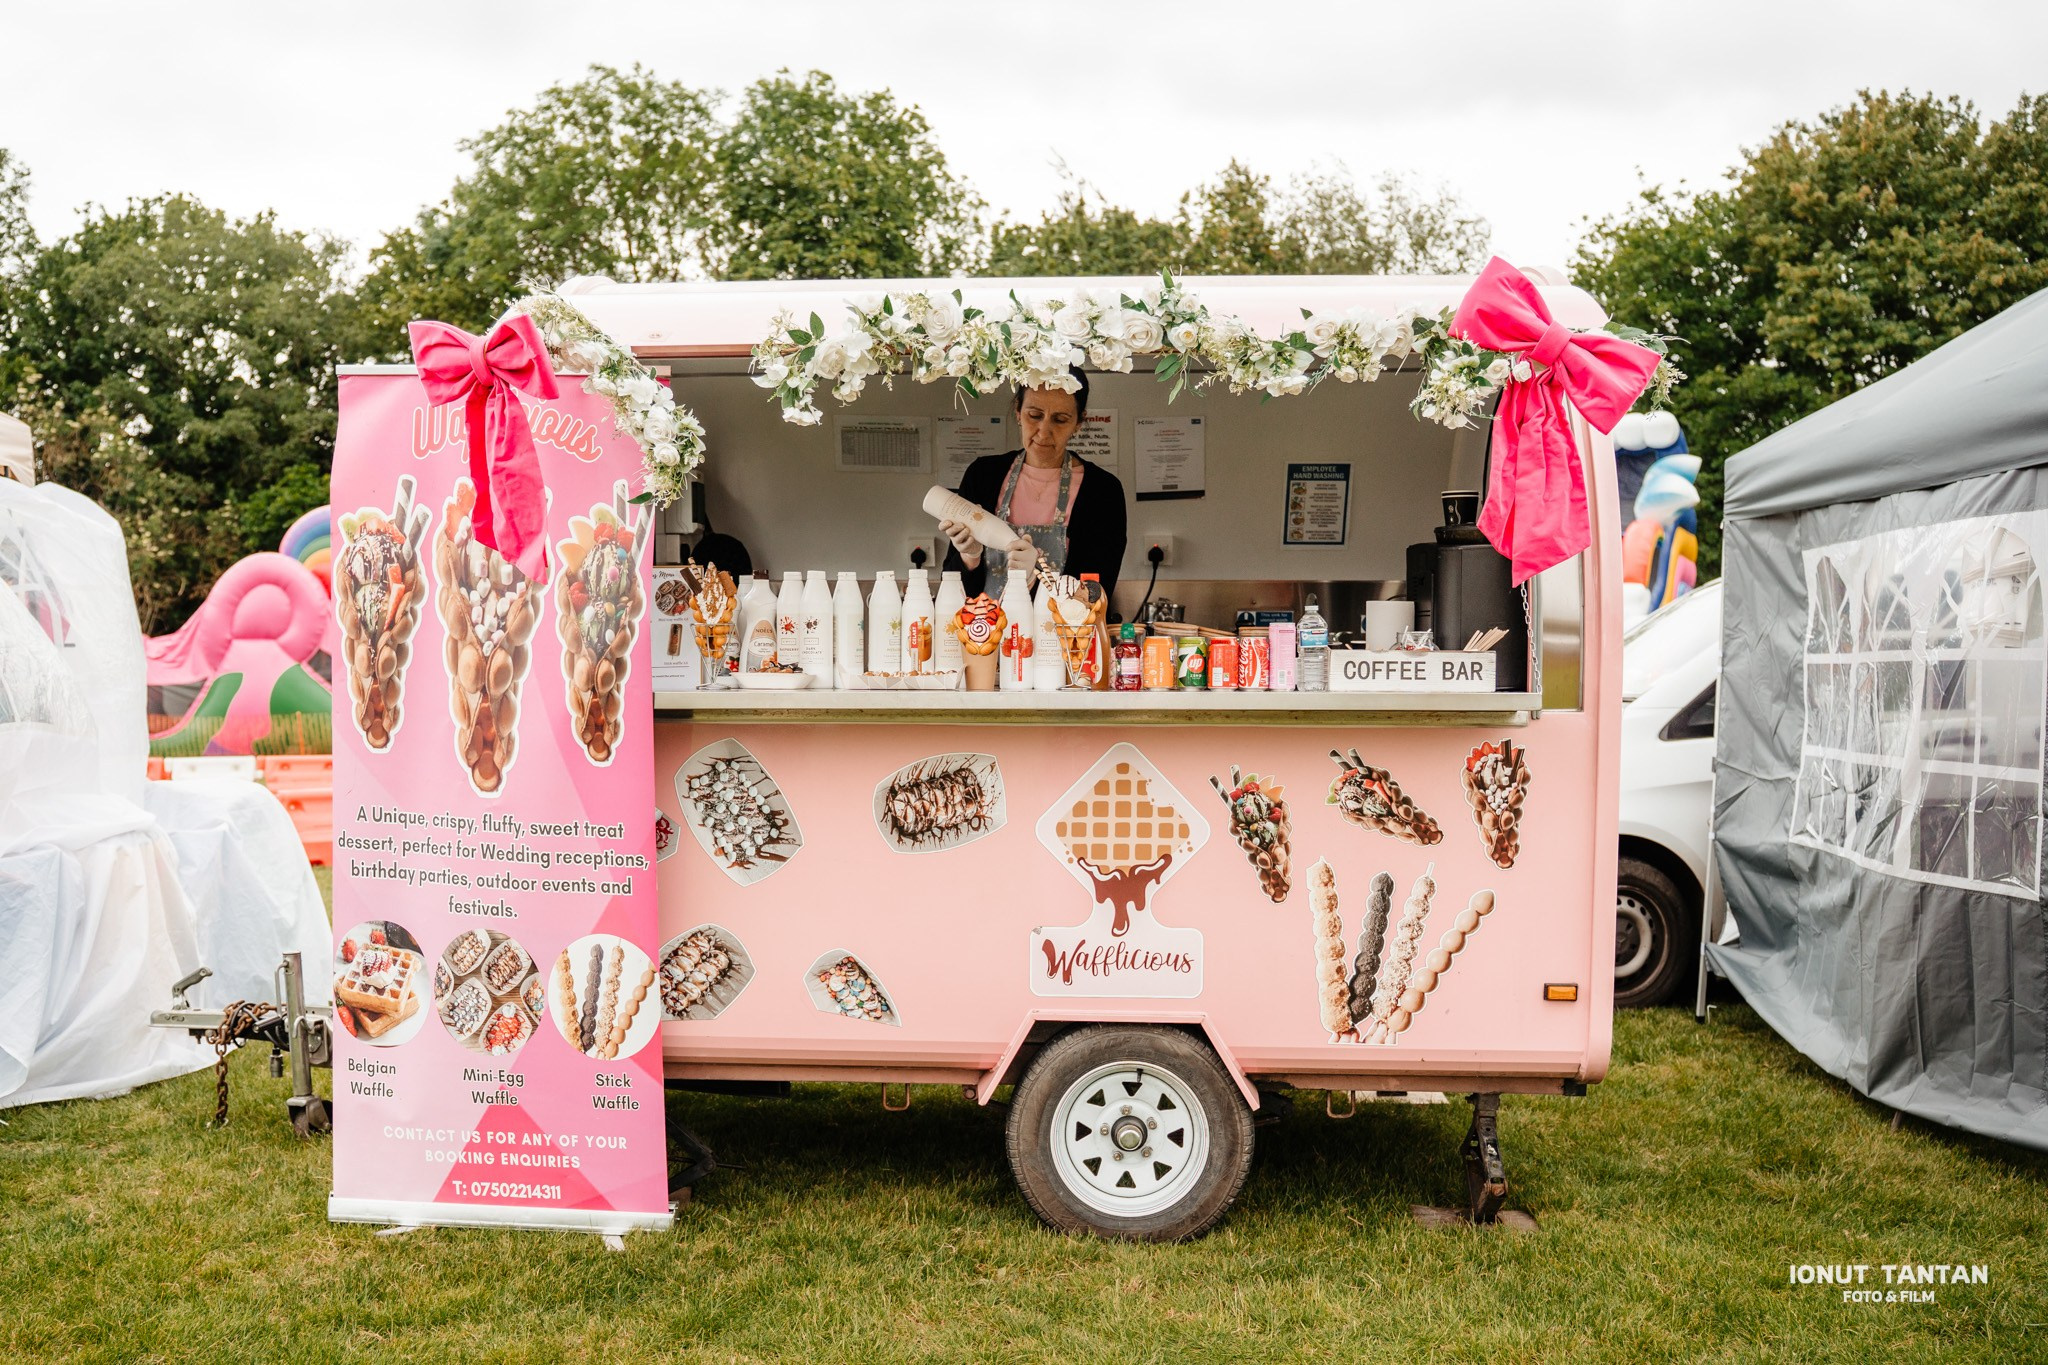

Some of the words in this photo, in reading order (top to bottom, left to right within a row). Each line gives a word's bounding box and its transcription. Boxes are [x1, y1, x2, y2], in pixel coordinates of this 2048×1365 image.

[412, 388, 604, 464] Waious
[1343, 660, 1427, 681] COFFEE
[1442, 661, 1483, 681] BAR
[356, 805, 367, 823] A
[372, 806, 429, 828] Unique,
[432, 812, 478, 836] crispy,
[482, 813, 526, 838] fluffy,
[530, 820, 580, 838] sweet
[584, 821, 625, 839] treat
[338, 831, 398, 856] dessert,
[402, 838, 453, 857] perfect
[456, 841, 477, 859] for
[481, 843, 551, 869] Wedding
[555, 850, 650, 871] receptions,
[351, 860, 416, 886] birthday
[419, 868, 473, 889] parties,
[476, 872, 537, 892] outdoor
[541, 878, 596, 894] events
[601, 877, 633, 895] and
[448, 895, 518, 918] festivals.
[1041, 938, 1195, 986] Wafflicious
[348, 1057, 397, 1078] Belgian
[463, 1067, 525, 1088] Mini-Egg
[350, 1081, 394, 1099] Waffle
[595, 1073, 633, 1089] Stick
[471, 1090, 519, 1106] Waffle
[592, 1094, 640, 1111] Waffle
[383, 1126, 456, 1143] CONTACT
[460, 1129, 482, 1144] US
[486, 1131, 517, 1146] FOR
[521, 1133, 553, 1147] ANY
[558, 1134, 579, 1148] OF
[584, 1135, 628, 1150] YOUR
[424, 1149, 496, 1165] BOOKING
[500, 1152, 581, 1169] ENQUIRIES
[452, 1181, 468, 1196] T:
[471, 1181, 562, 1200] 07502214311
